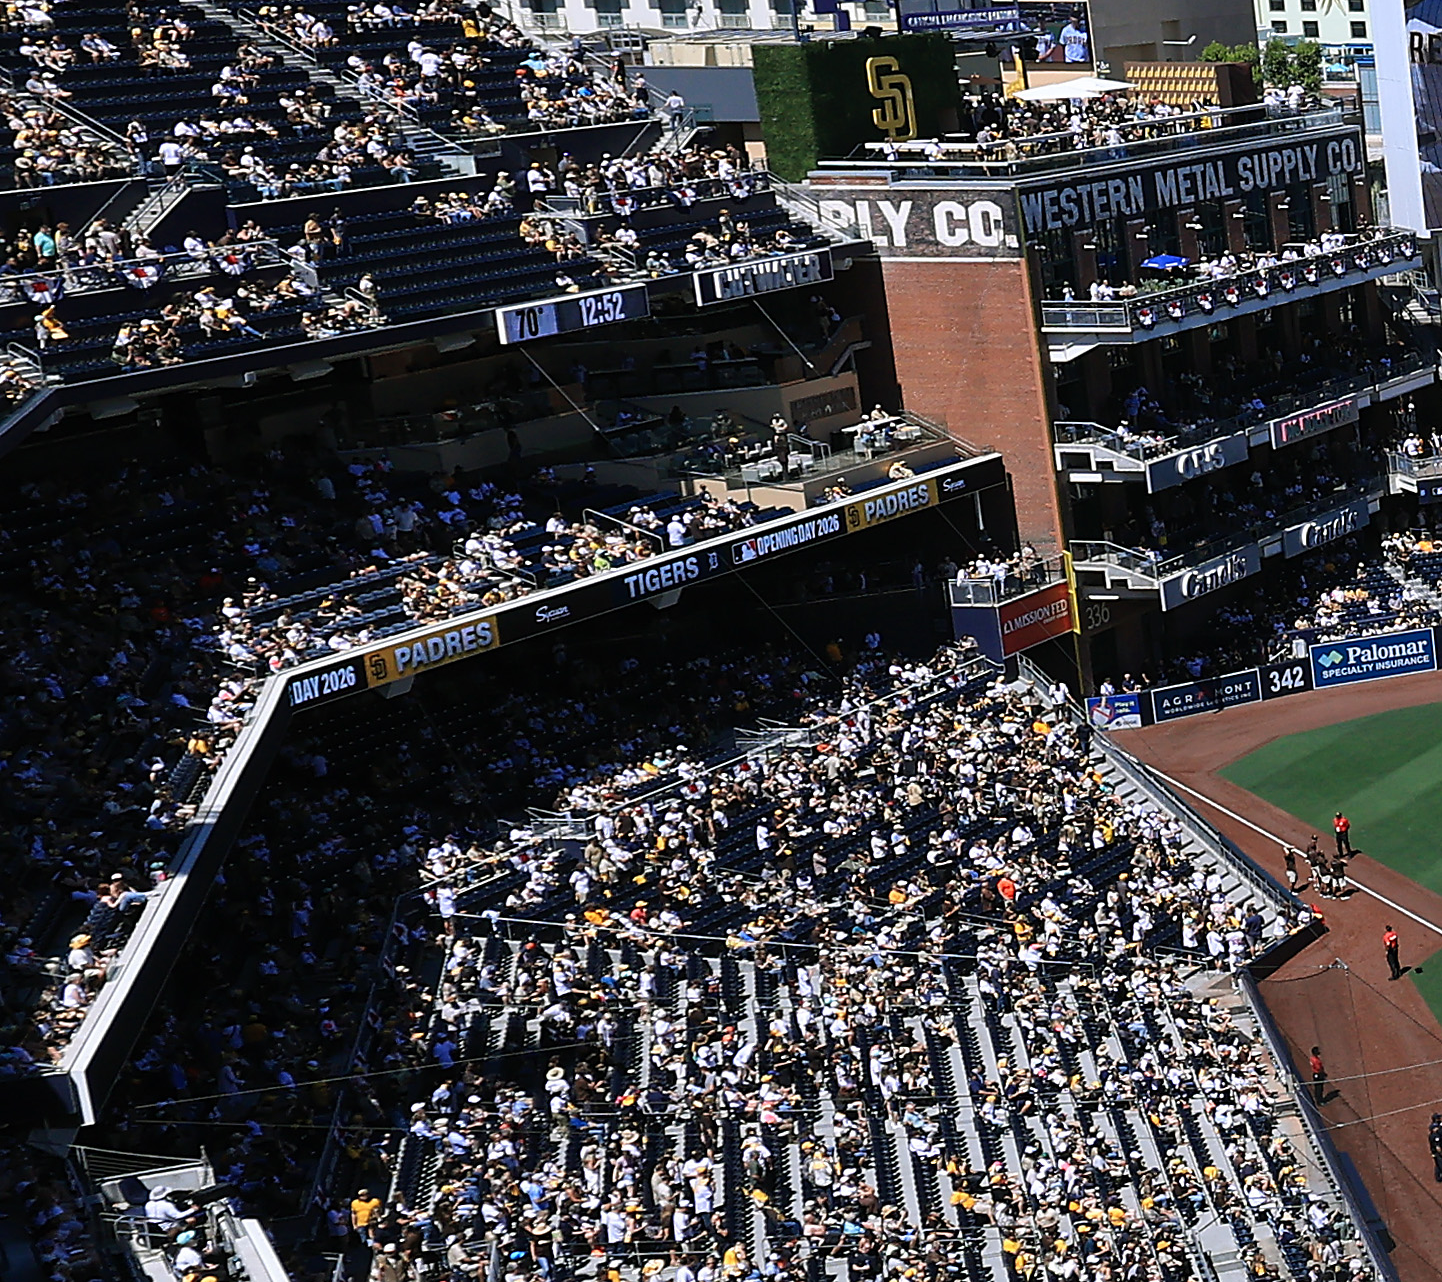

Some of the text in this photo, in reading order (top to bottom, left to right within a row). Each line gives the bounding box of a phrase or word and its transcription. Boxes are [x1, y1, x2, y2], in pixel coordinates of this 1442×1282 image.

[866, 56, 918, 140] SD
[1021, 138, 1362, 232] WESTERN METAL SUPPLY CO.
[931, 200, 1019, 248] CO.
[578, 292, 626, 327] 12:52
[864, 485, 930, 522] PADRES
[757, 513, 841, 557] OPENING DAY 2026
[624, 556, 700, 599] TIGERS
[1014, 599, 1068, 631] MISSION FED
[1085, 603, 1111, 631] 336
[393, 622, 493, 673] PADRES
[1321, 653, 1431, 679] SPECIALTY INSURANCE
[1346, 639, 1429, 664] Palomar
[292, 665, 357, 706] DAY 2026
[1269, 666, 1305, 693] 342
